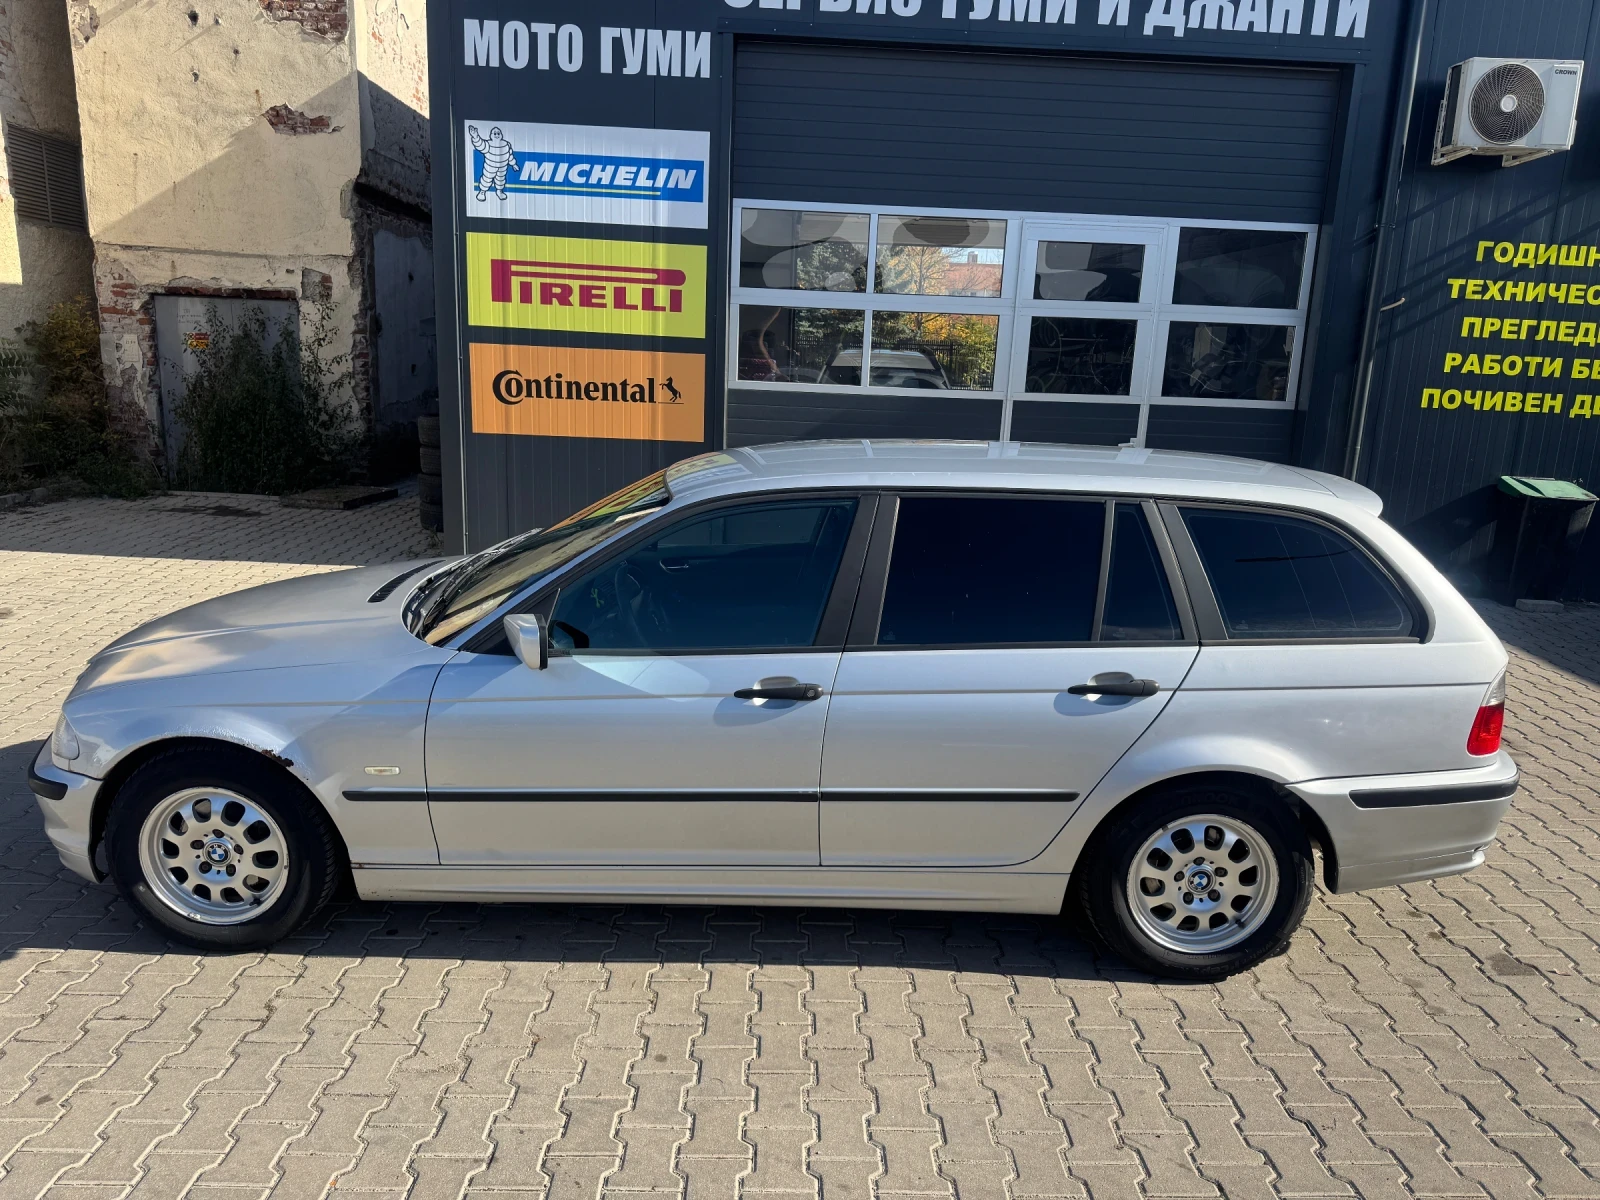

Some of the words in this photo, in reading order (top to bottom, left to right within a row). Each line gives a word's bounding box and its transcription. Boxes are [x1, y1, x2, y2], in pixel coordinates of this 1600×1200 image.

[463, 18, 583, 73] МОТО
[600, 26, 711, 79] ГУМИ
[519, 161, 697, 190] MICHELIN
[490, 258, 687, 313] PIRELLI
[1460, 316, 1600, 347] ПРЕГЛЕД
[1443, 352, 1563, 378] РАБОТИ
[492, 369, 657, 405] Continental
[1420, 387, 1564, 414] ПОЧИВЕН
